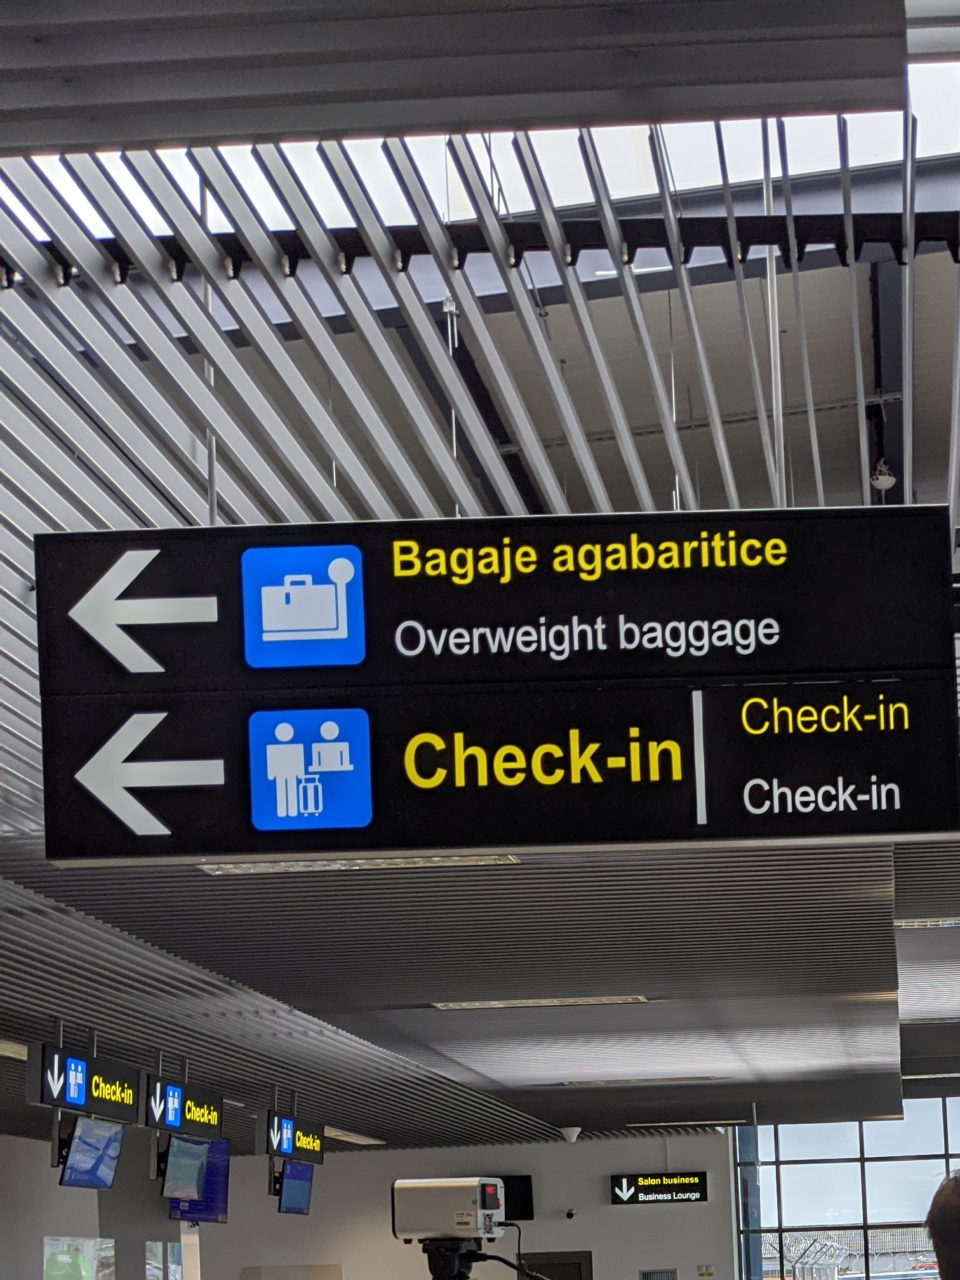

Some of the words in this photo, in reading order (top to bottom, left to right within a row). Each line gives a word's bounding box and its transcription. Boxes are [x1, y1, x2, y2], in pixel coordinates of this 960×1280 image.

[392, 536, 538, 585] Bagaje
[552, 530, 788, 582] agabaritice
[394, 614, 608, 661] Overweight
[618, 614, 781, 656] baggage
[741, 694, 910, 736] Check-in
[403, 726, 683, 789] Check-in
[743, 776, 902, 816] Check-in
[92, 1075, 133, 1105] Check-in
[185, 1100, 218, 1126] Check-in
[295, 1130, 320, 1151] Check-in
[638, 1176, 661, 1186] Salon
[662, 1175, 699, 1185] business
[638, 1192, 672, 1200] Business
[673, 1191, 701, 1201] Lounge
